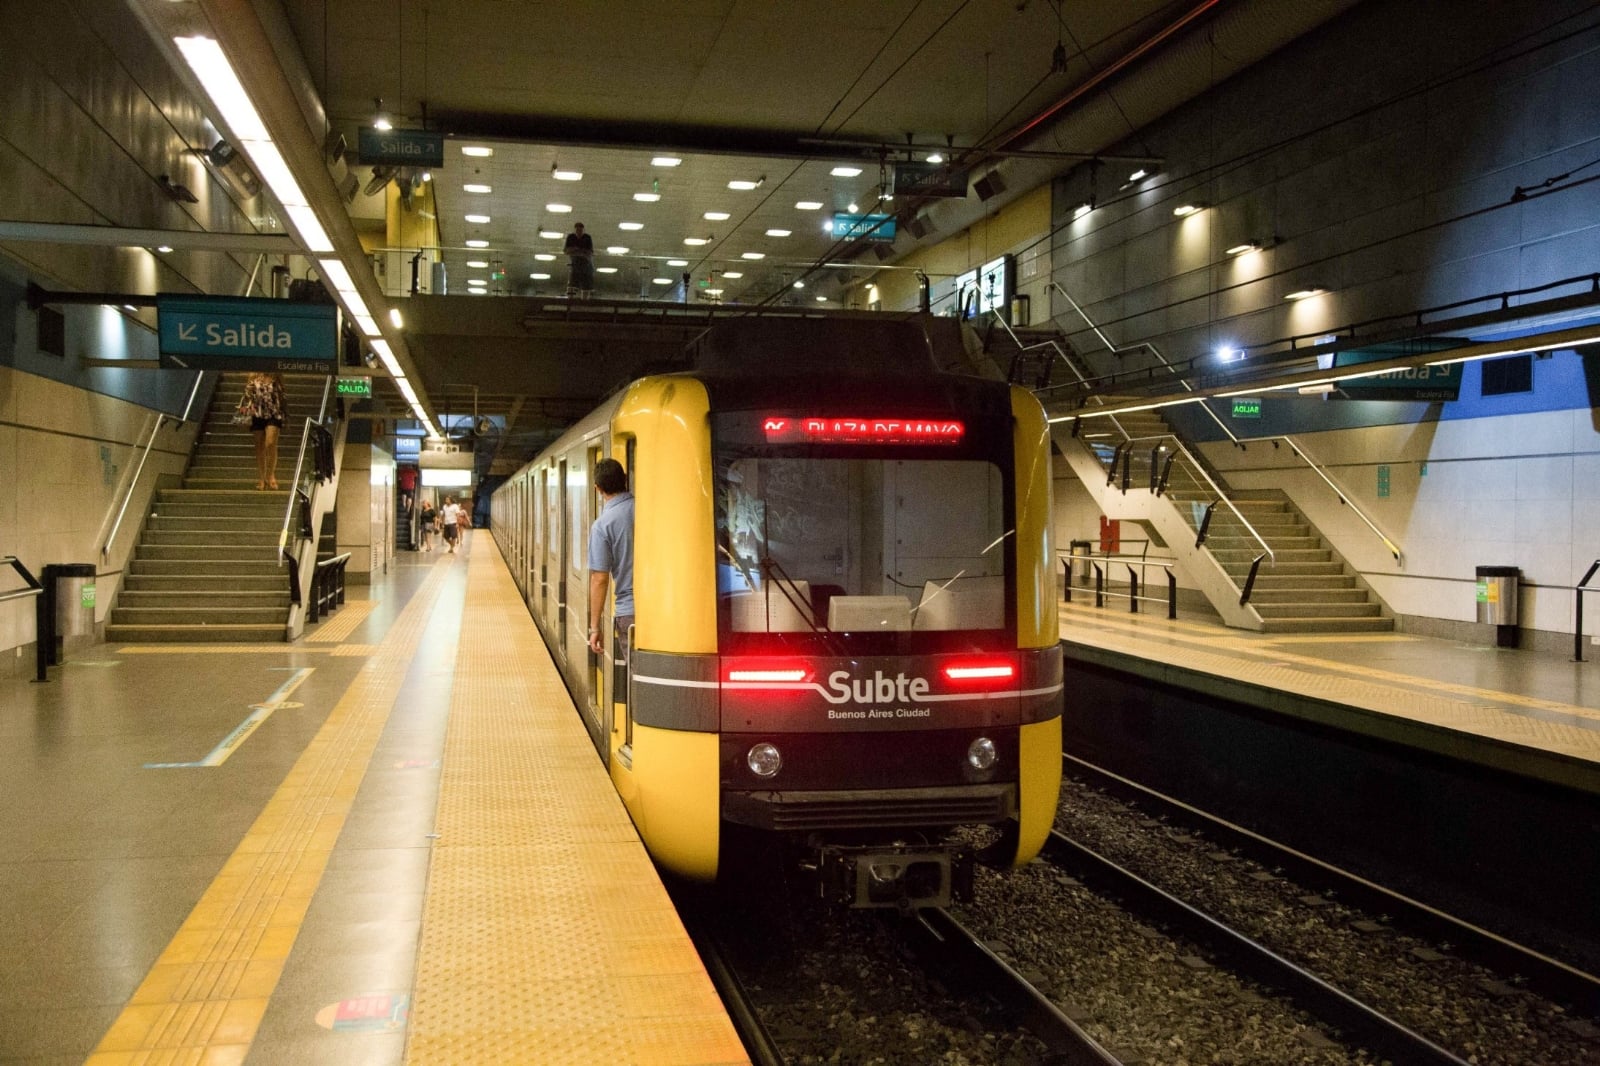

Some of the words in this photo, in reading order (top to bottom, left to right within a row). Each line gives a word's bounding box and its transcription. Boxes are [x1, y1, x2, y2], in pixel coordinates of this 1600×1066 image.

[380, 140, 421, 154] Salida
[849, 222, 880, 234] Salida
[206, 323, 292, 348] Salida
[277, 360, 312, 370] Escalera
[315, 361, 330, 373] Fija
[337, 385, 370, 394] SALIDA
[828, 671, 930, 704] Subte
[828, 709, 866, 719] Buenos
[868, 709, 894, 719] Aires
[896, 708, 931, 718] Ciudad
